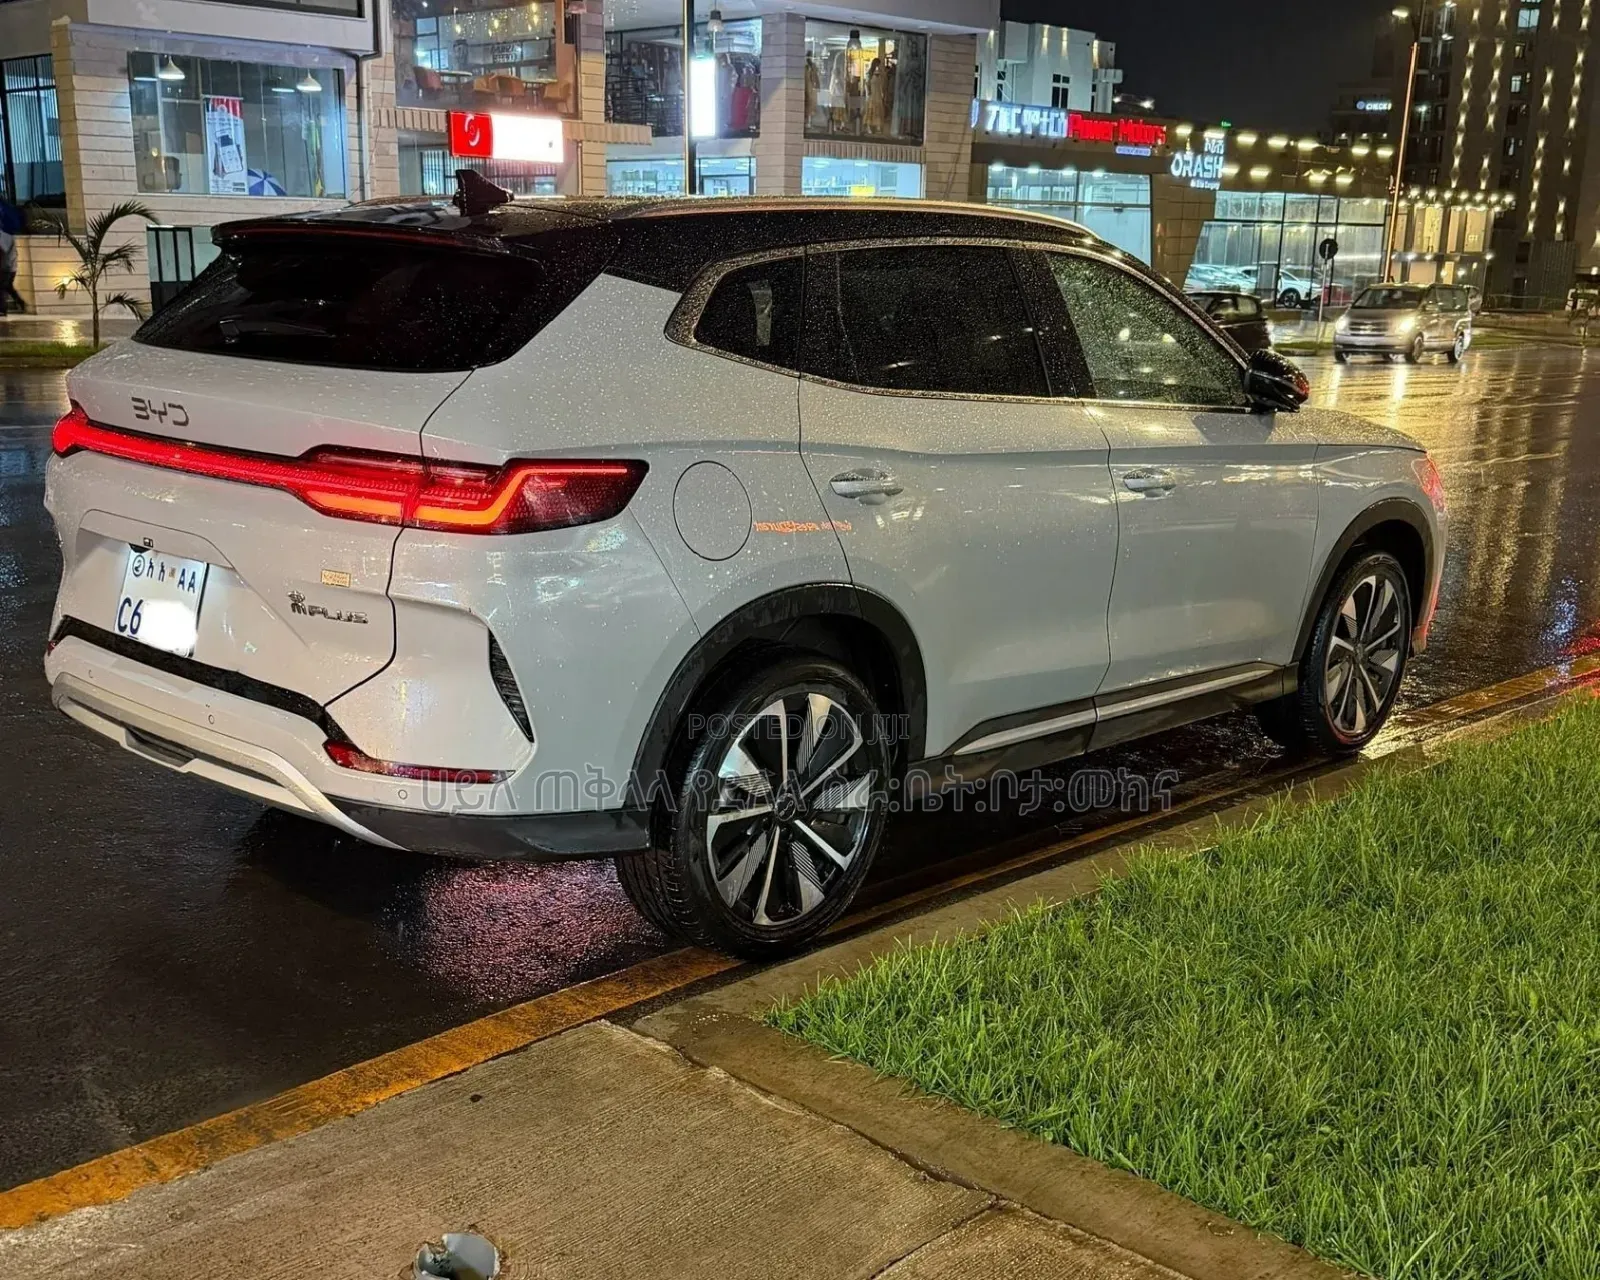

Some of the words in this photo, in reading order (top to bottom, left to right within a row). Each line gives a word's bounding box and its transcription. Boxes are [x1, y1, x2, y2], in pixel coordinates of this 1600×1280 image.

[1068, 112, 1118, 142] Power
[1118, 118, 1167, 145] Motors
[1171, 152, 1224, 178] ORASH
[131, 396, 190, 427] BYD
[177, 568, 197, 595] AA
[307, 604, 370, 625] PLUS
